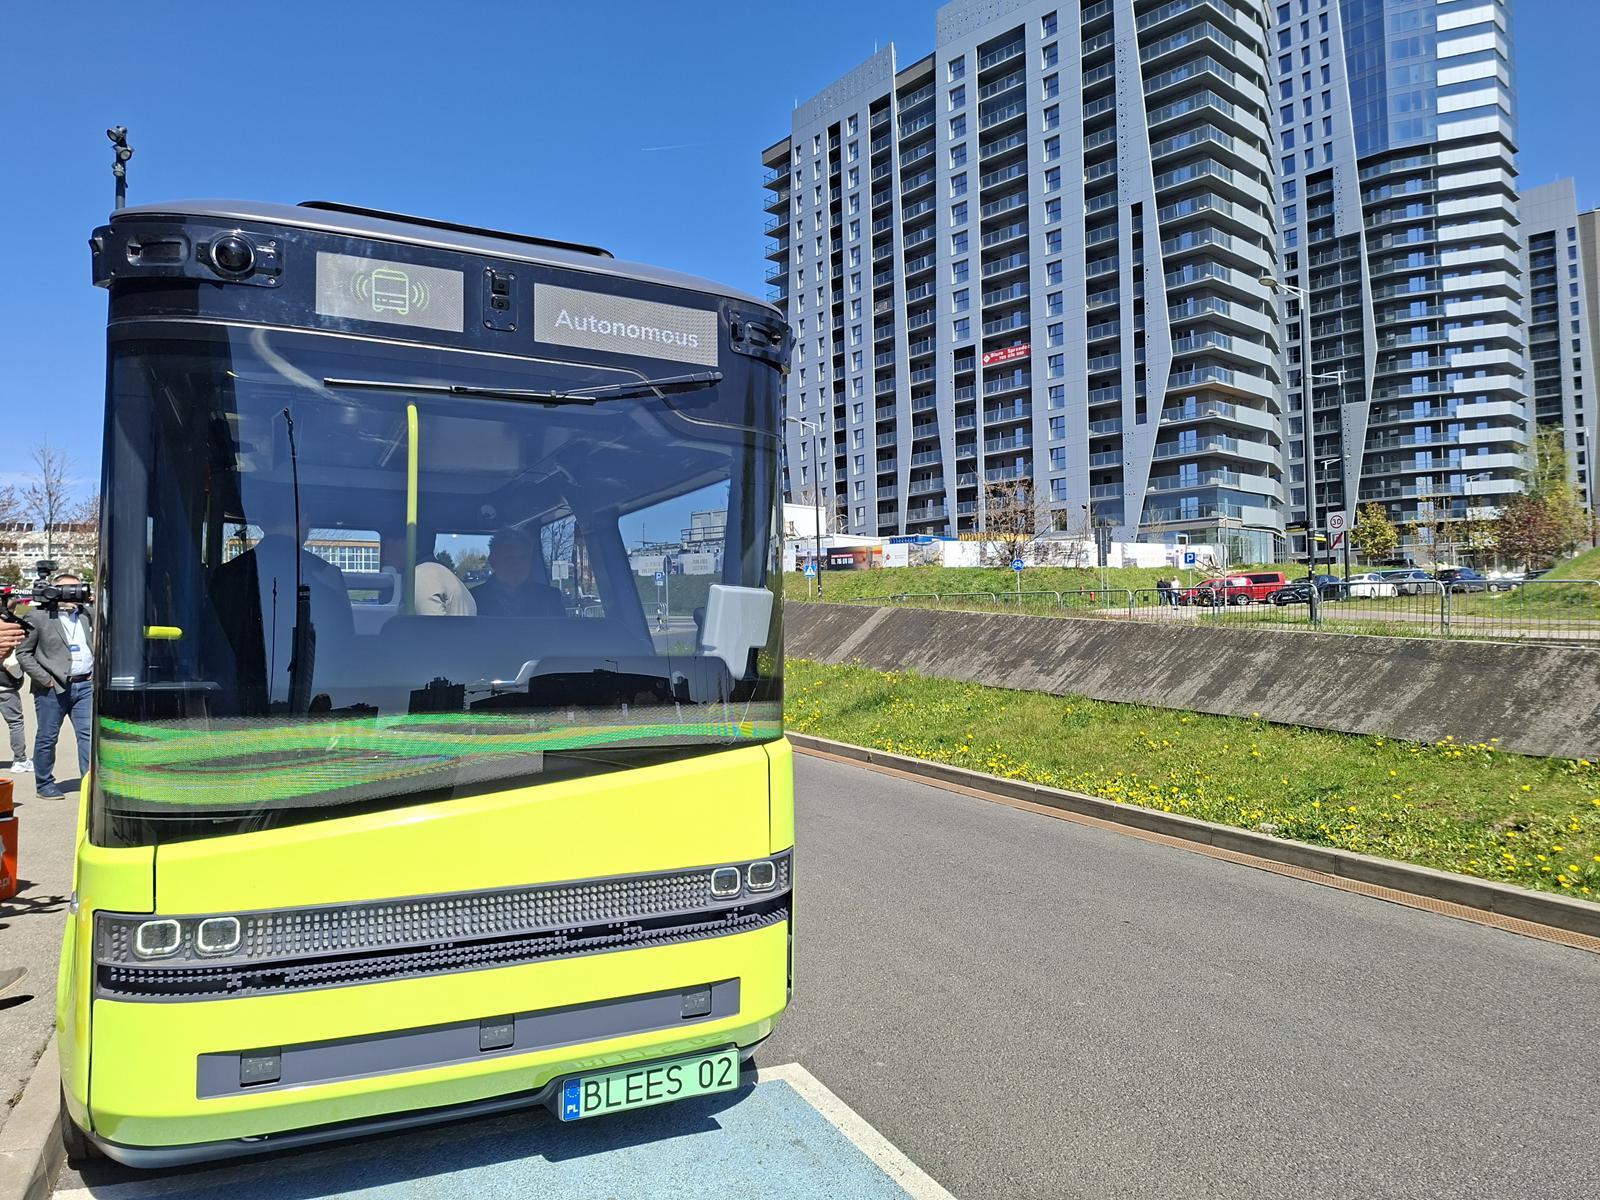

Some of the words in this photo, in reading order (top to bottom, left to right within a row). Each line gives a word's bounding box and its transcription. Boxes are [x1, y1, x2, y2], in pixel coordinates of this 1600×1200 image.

[555, 309, 699, 348] Autonomous
[1332, 518, 1342, 526] 30
[1186, 553, 1194, 563] P
[584, 1065, 682, 1112] BLEES
[699, 1056, 732, 1088] 02
[566, 1104, 578, 1114] PL
